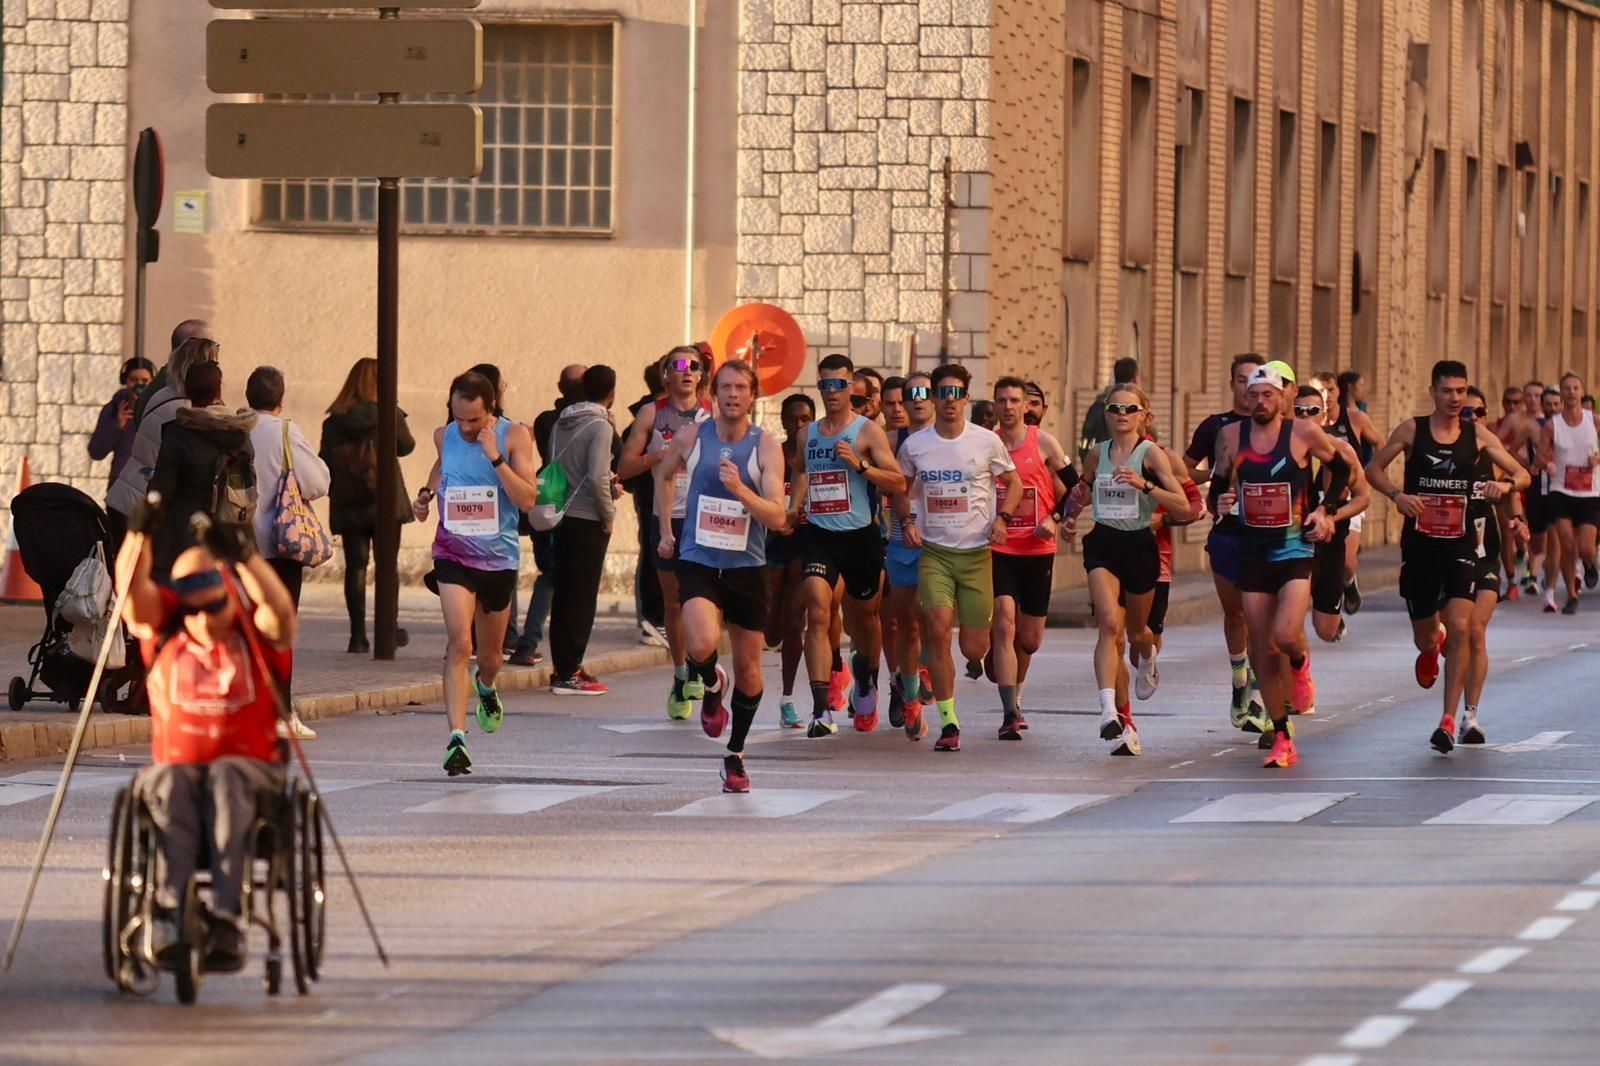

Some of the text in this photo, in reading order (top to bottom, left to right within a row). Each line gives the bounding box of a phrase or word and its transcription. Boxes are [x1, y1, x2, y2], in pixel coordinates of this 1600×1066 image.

[920, 470, 962, 481] asisa
[1419, 477, 1468, 490] RUNNER'S
[1104, 490, 1125, 498] 14742
[935, 499, 958, 507] 10024
[456, 504, 483, 513] 10079
[709, 515, 736, 527] 10044
